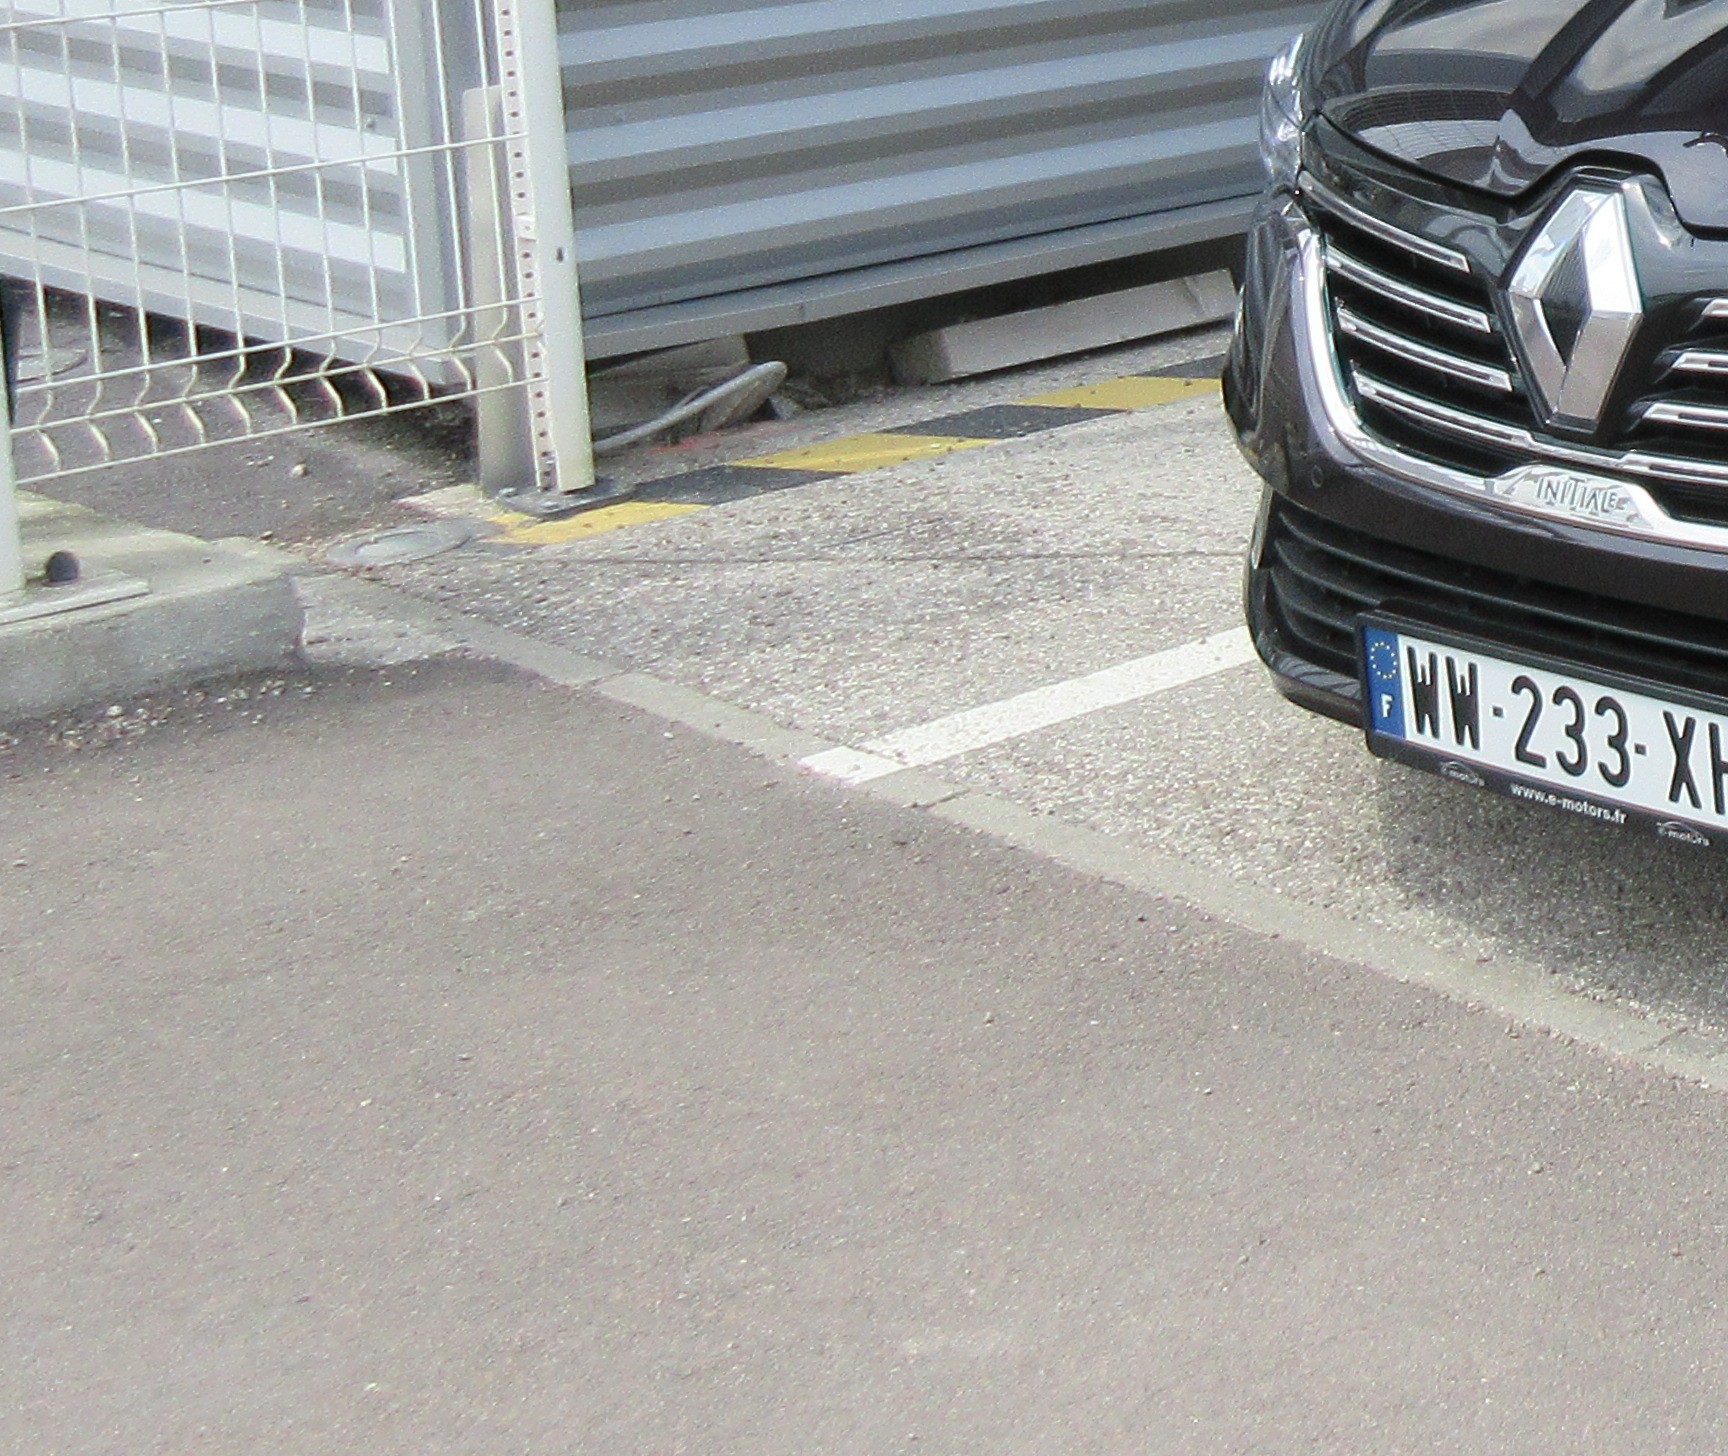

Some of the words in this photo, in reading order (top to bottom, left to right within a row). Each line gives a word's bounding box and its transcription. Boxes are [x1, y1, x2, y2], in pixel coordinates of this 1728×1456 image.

[1536, 476, 1621, 514] INITIALE
[1379, 693, 1394, 718] F
[1510, 782, 1628, 824] www.e-motors.fr
